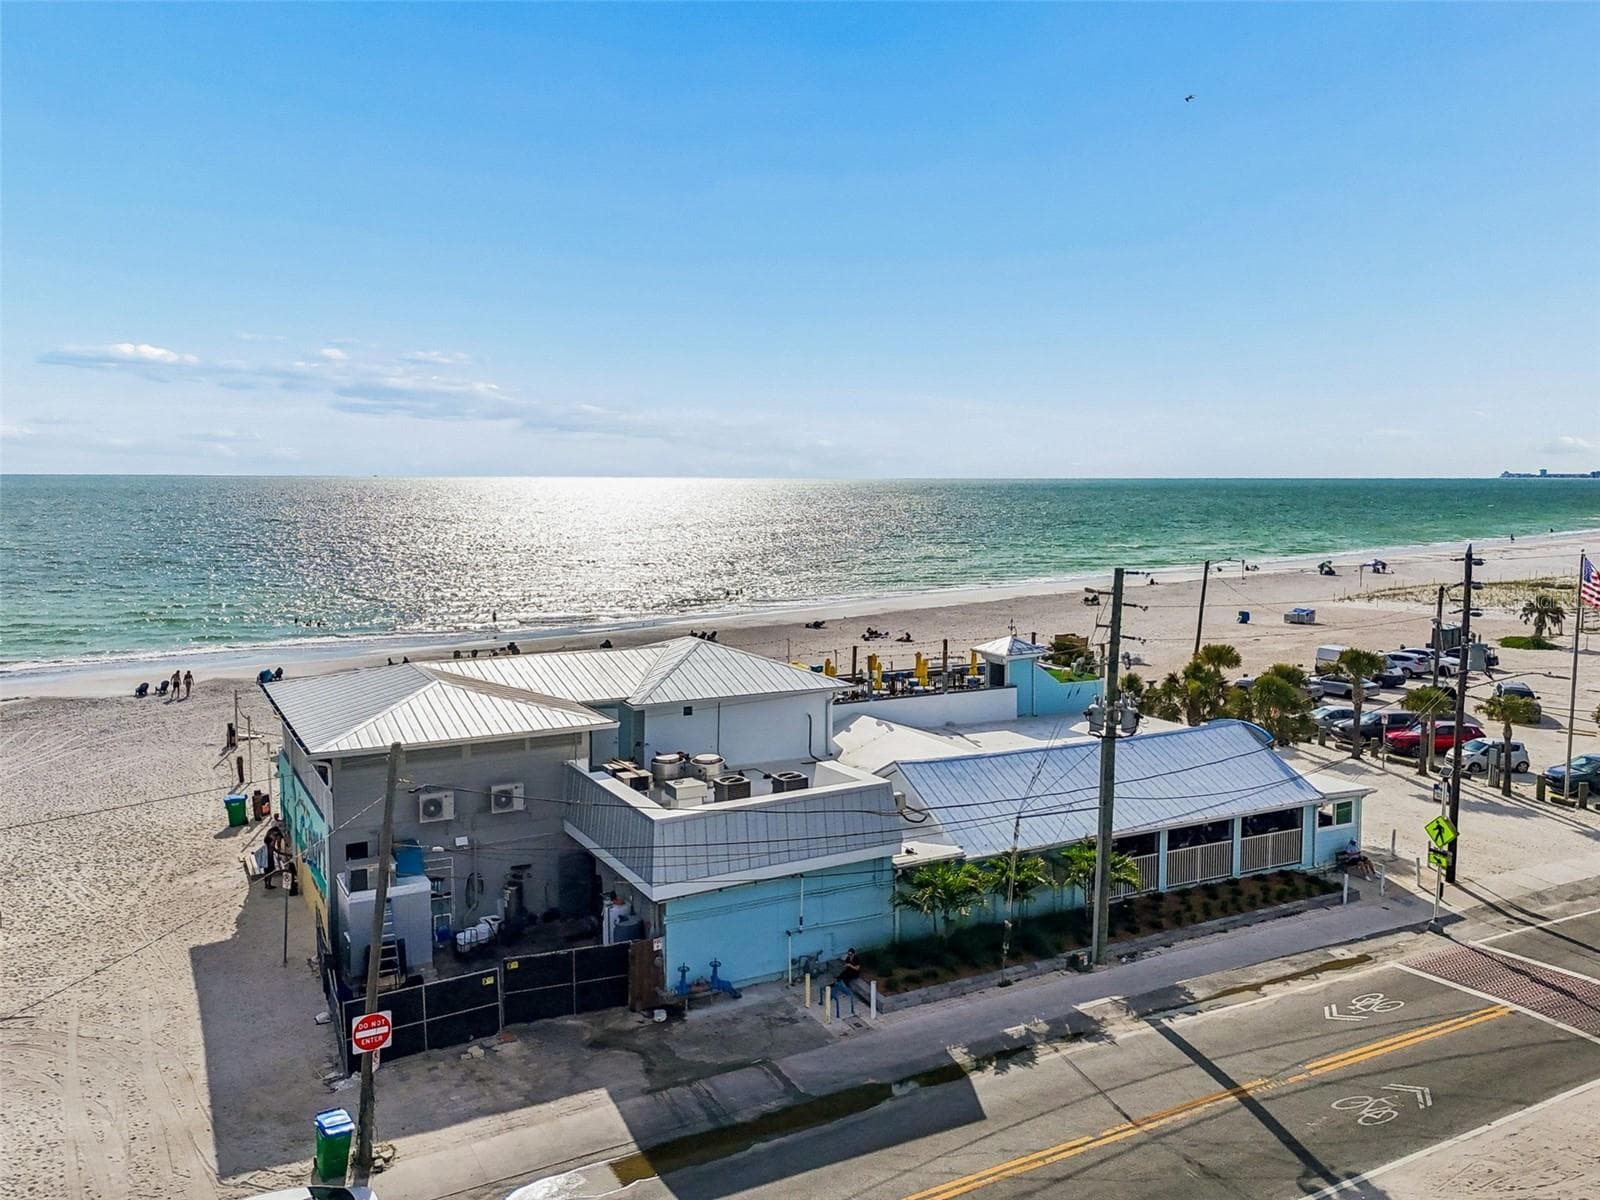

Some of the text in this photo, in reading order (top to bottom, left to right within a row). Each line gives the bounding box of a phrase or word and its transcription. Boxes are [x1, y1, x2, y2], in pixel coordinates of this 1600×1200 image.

[358, 1018, 386, 1030] DO NOT
[361, 1035, 383, 1046] ENTER
